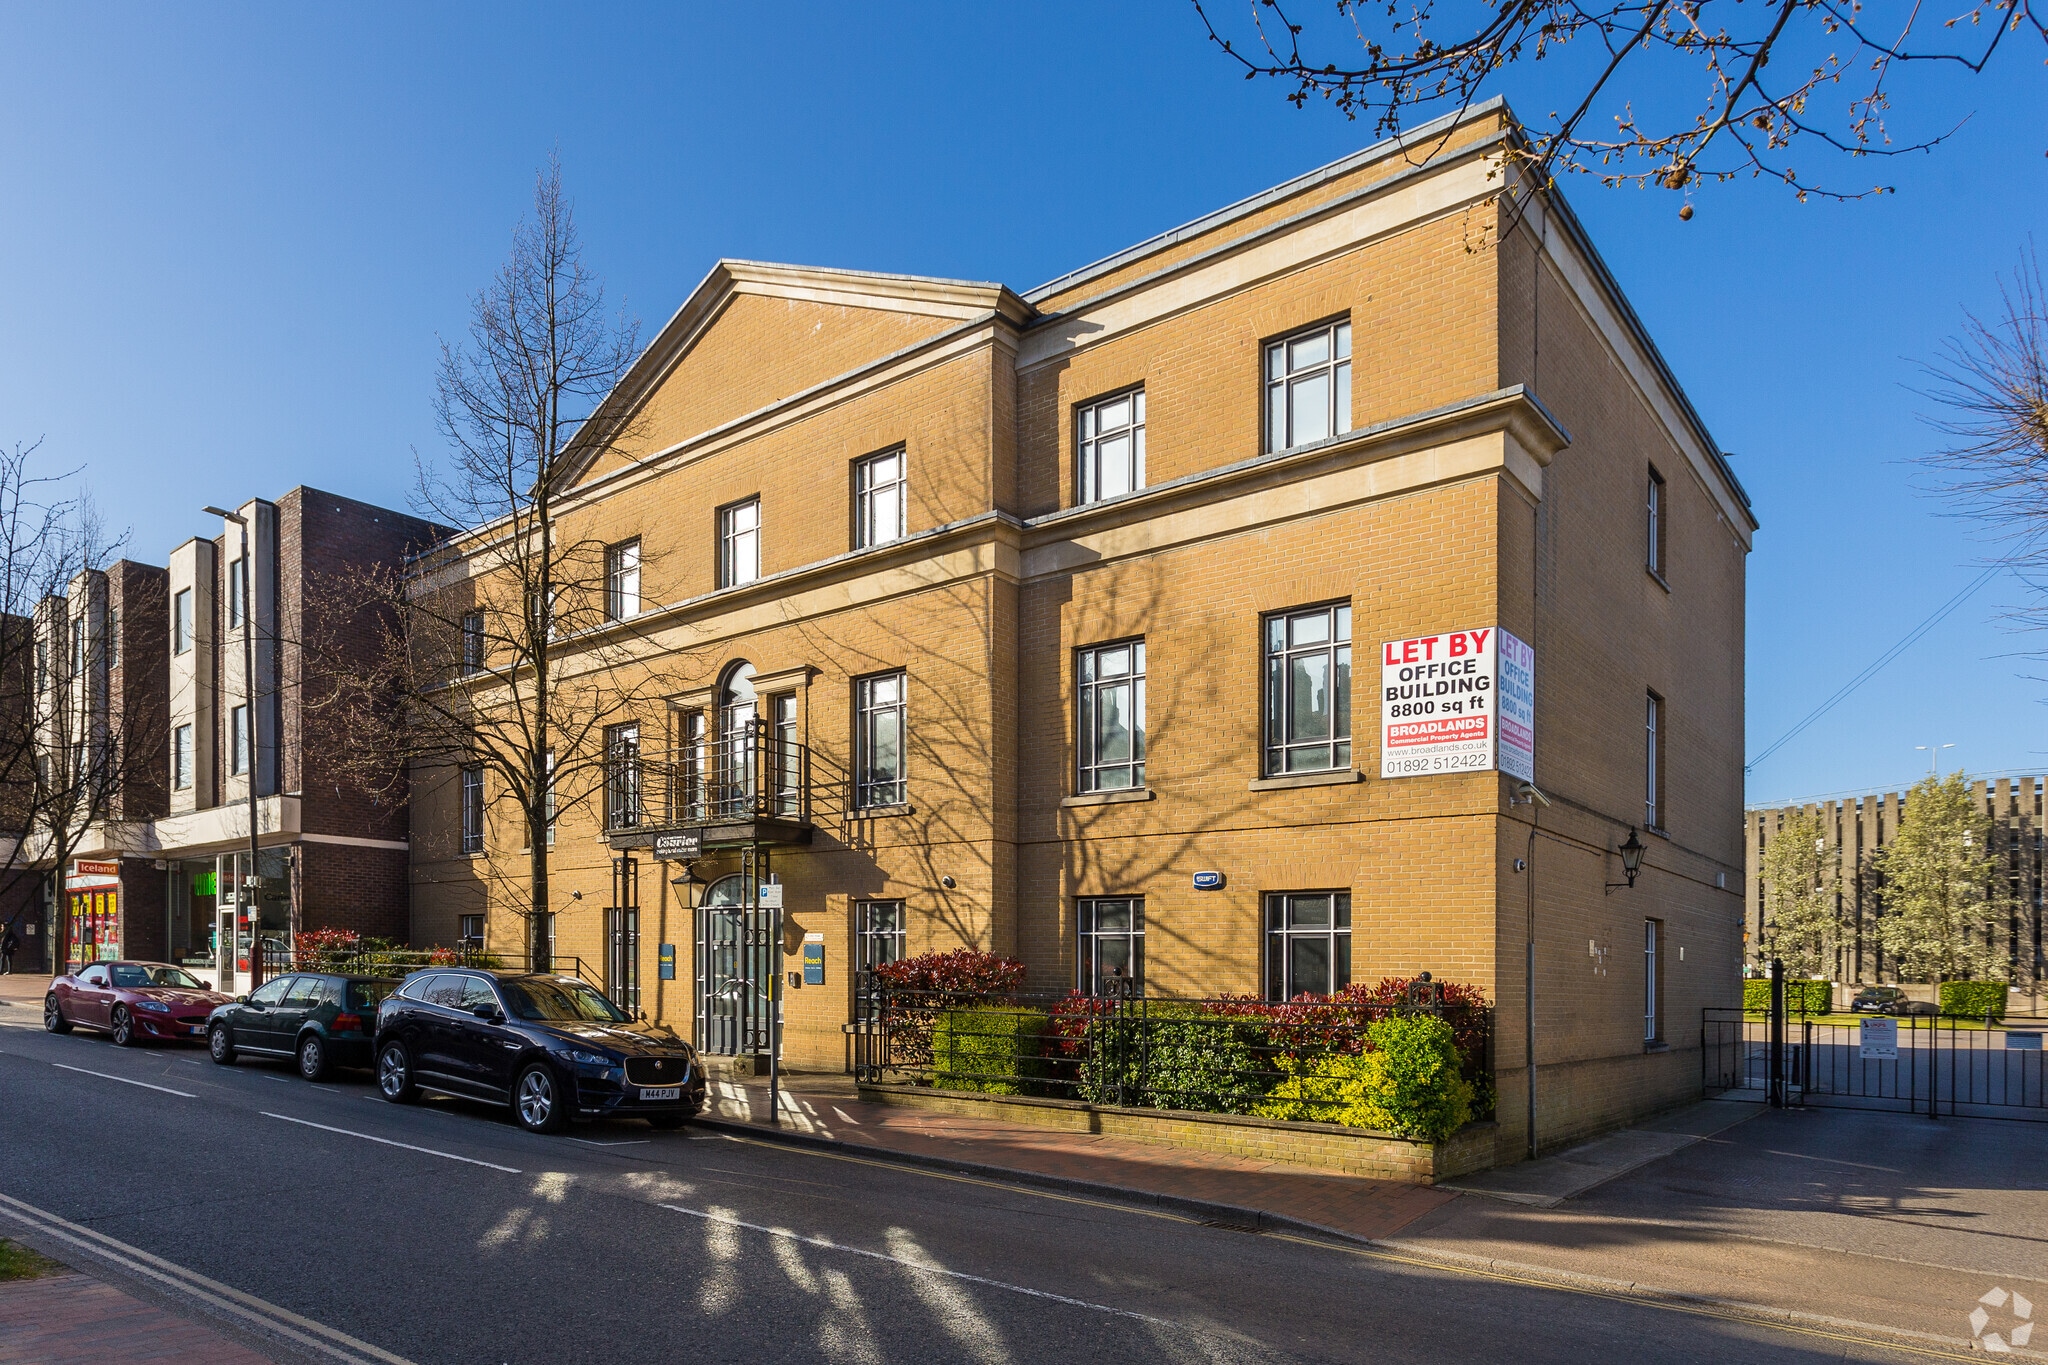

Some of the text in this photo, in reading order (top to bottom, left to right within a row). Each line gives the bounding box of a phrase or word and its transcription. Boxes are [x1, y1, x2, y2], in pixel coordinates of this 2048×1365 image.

[1386, 629, 1490, 665] LET BY
[1500, 630, 1533, 671] LET BY
[1399, 659, 1476, 682] OFFICE
[1504, 660, 1529, 687] OFFICE
[1386, 675, 1490, 701] BUILDING
[1500, 675, 1532, 706] BUILDING
[1391, 696, 1484, 717] 8800 sq ft
[1501, 695, 1532, 723] 8800 sq ft
[1390, 717, 1485, 737] BROADLANDS
[1387, 740, 1487, 757] www.broadlands.co.uk
[1390, 731, 1484, 745] Commercial Property Agents
[1387, 753, 1487, 774] 01892 512422
[1501, 754, 1516, 772] 01892
[81, 863, 116, 873] Iceland
[804, 956, 822, 965] Reach
